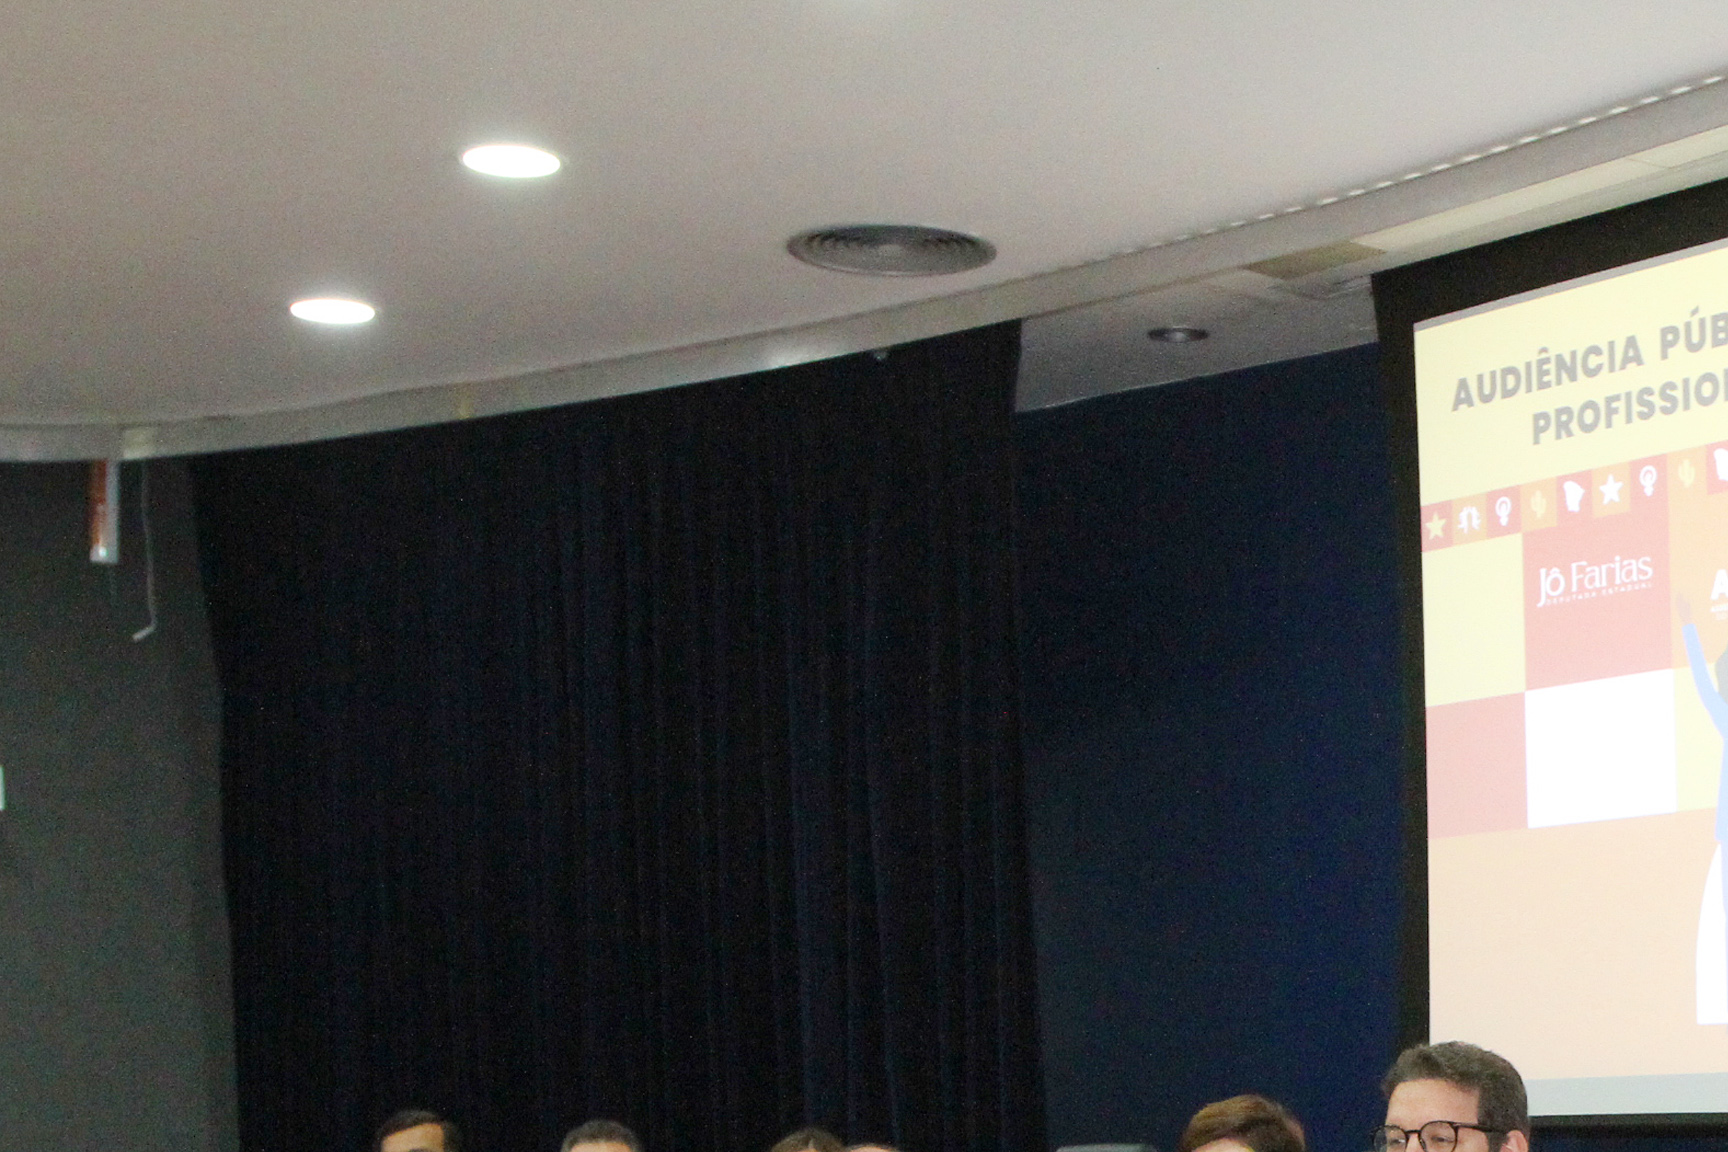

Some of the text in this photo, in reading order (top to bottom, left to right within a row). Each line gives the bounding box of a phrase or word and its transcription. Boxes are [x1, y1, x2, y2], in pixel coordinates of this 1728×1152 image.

[1452, 336, 1644, 411] AUDIÊNCIA
[1536, 555, 1654, 608] Jô Farias
